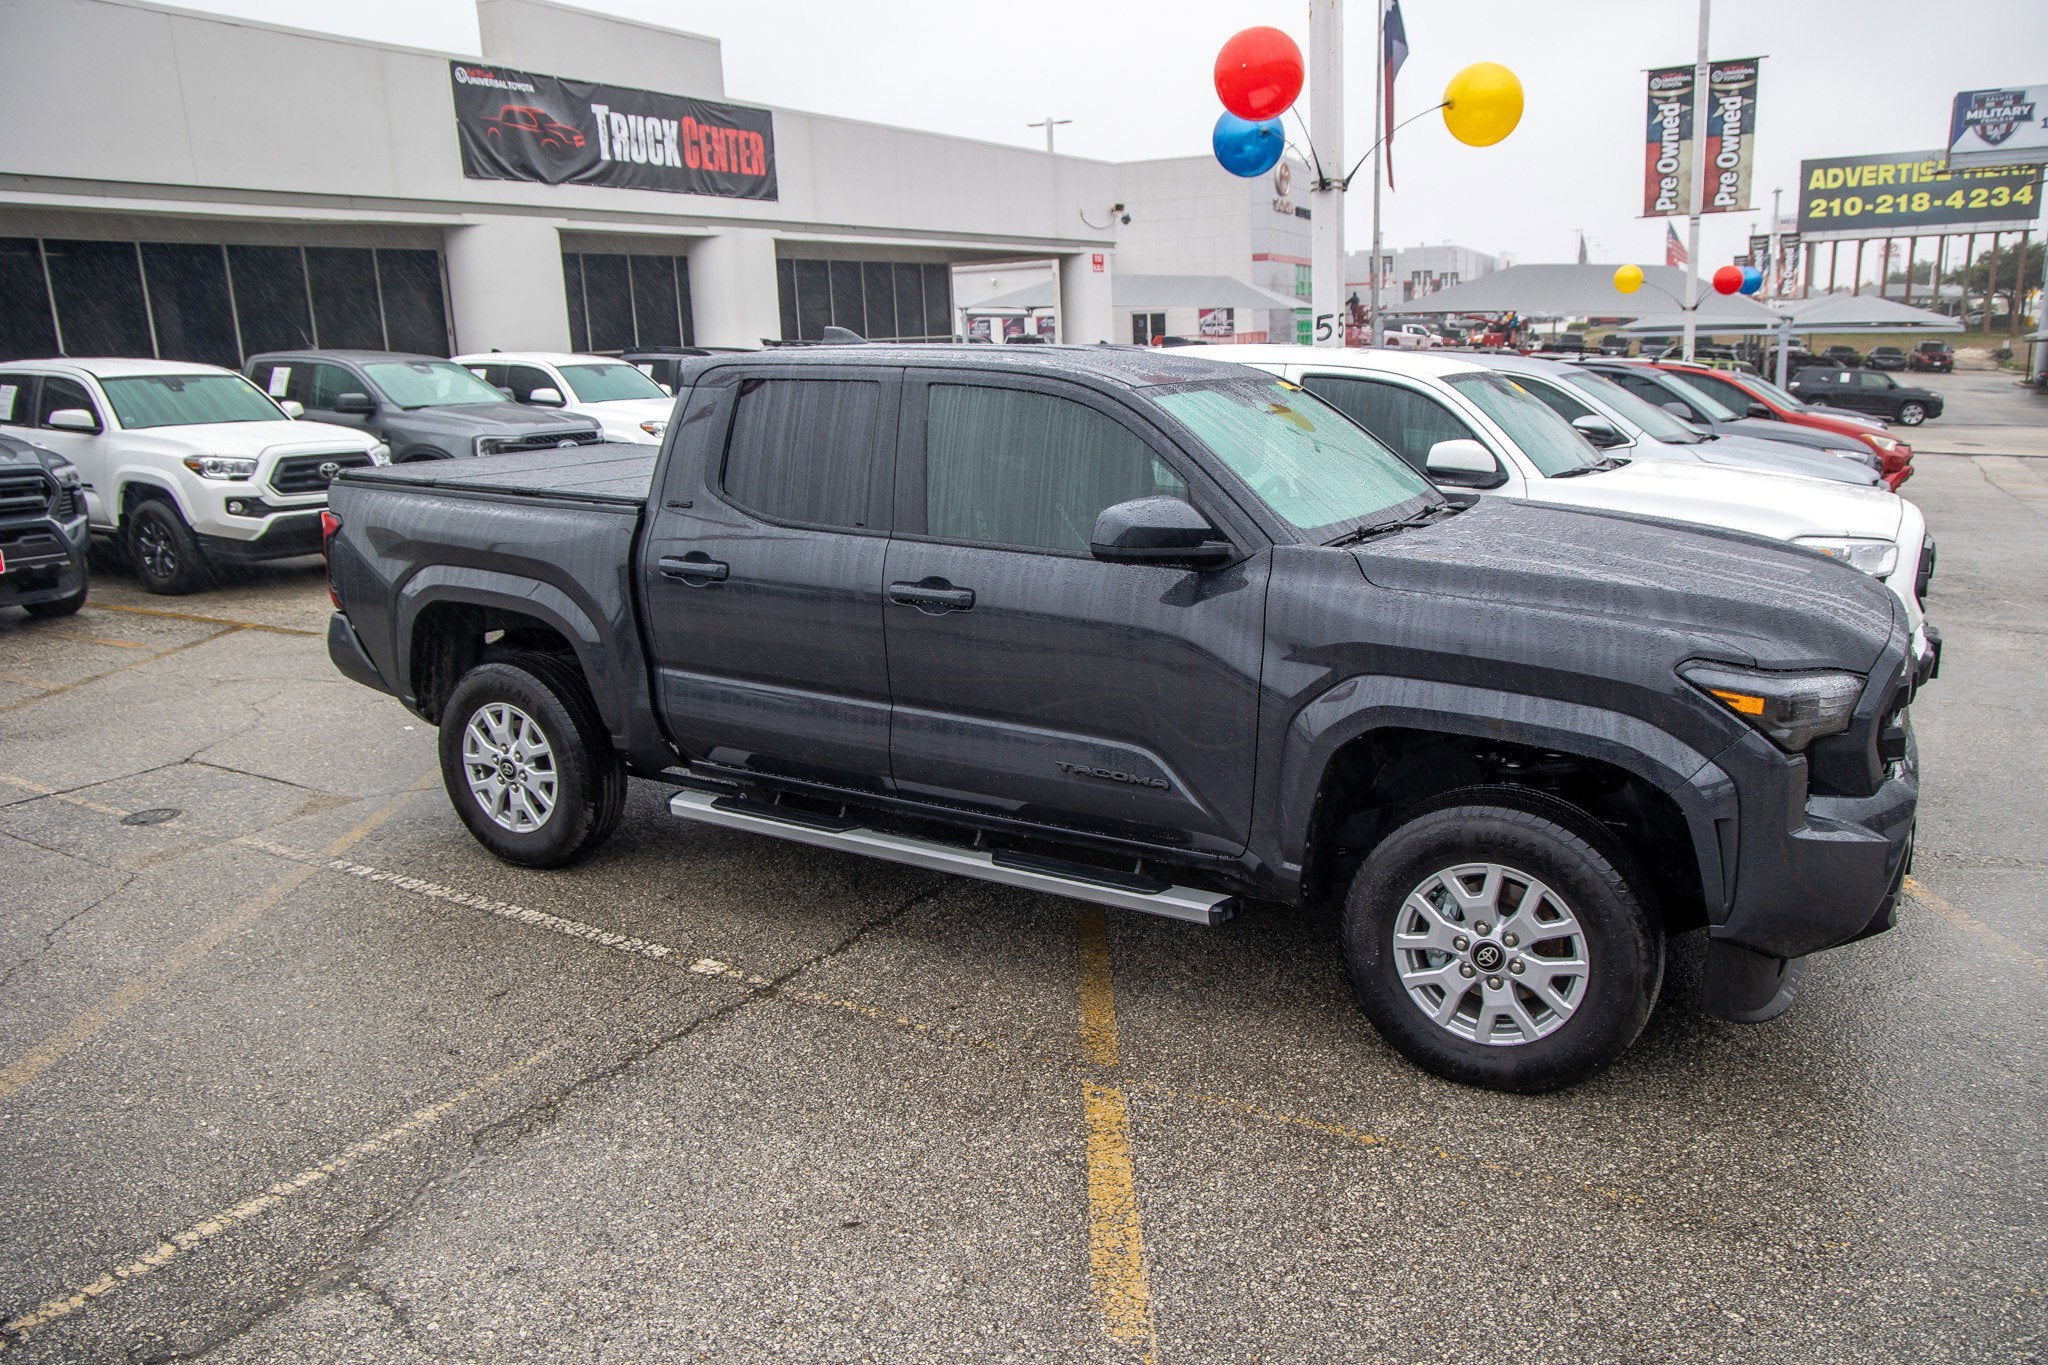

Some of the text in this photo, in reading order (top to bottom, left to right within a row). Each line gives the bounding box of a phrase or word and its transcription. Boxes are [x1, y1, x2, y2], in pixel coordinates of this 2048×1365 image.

[467, 76, 535, 93] UNIVERSAL TOYOTA
[1965, 104, 2031, 120] MILITARY
[590, 103, 766, 176] TRUCK CENTER
[1656, 102, 1681, 174] Owned
[1716, 96, 1743, 169] Owned
[1655, 176, 1679, 211] Pre
[1713, 171, 1739, 206] Pre
[1808, 185, 2034, 218] 210-218-4234
